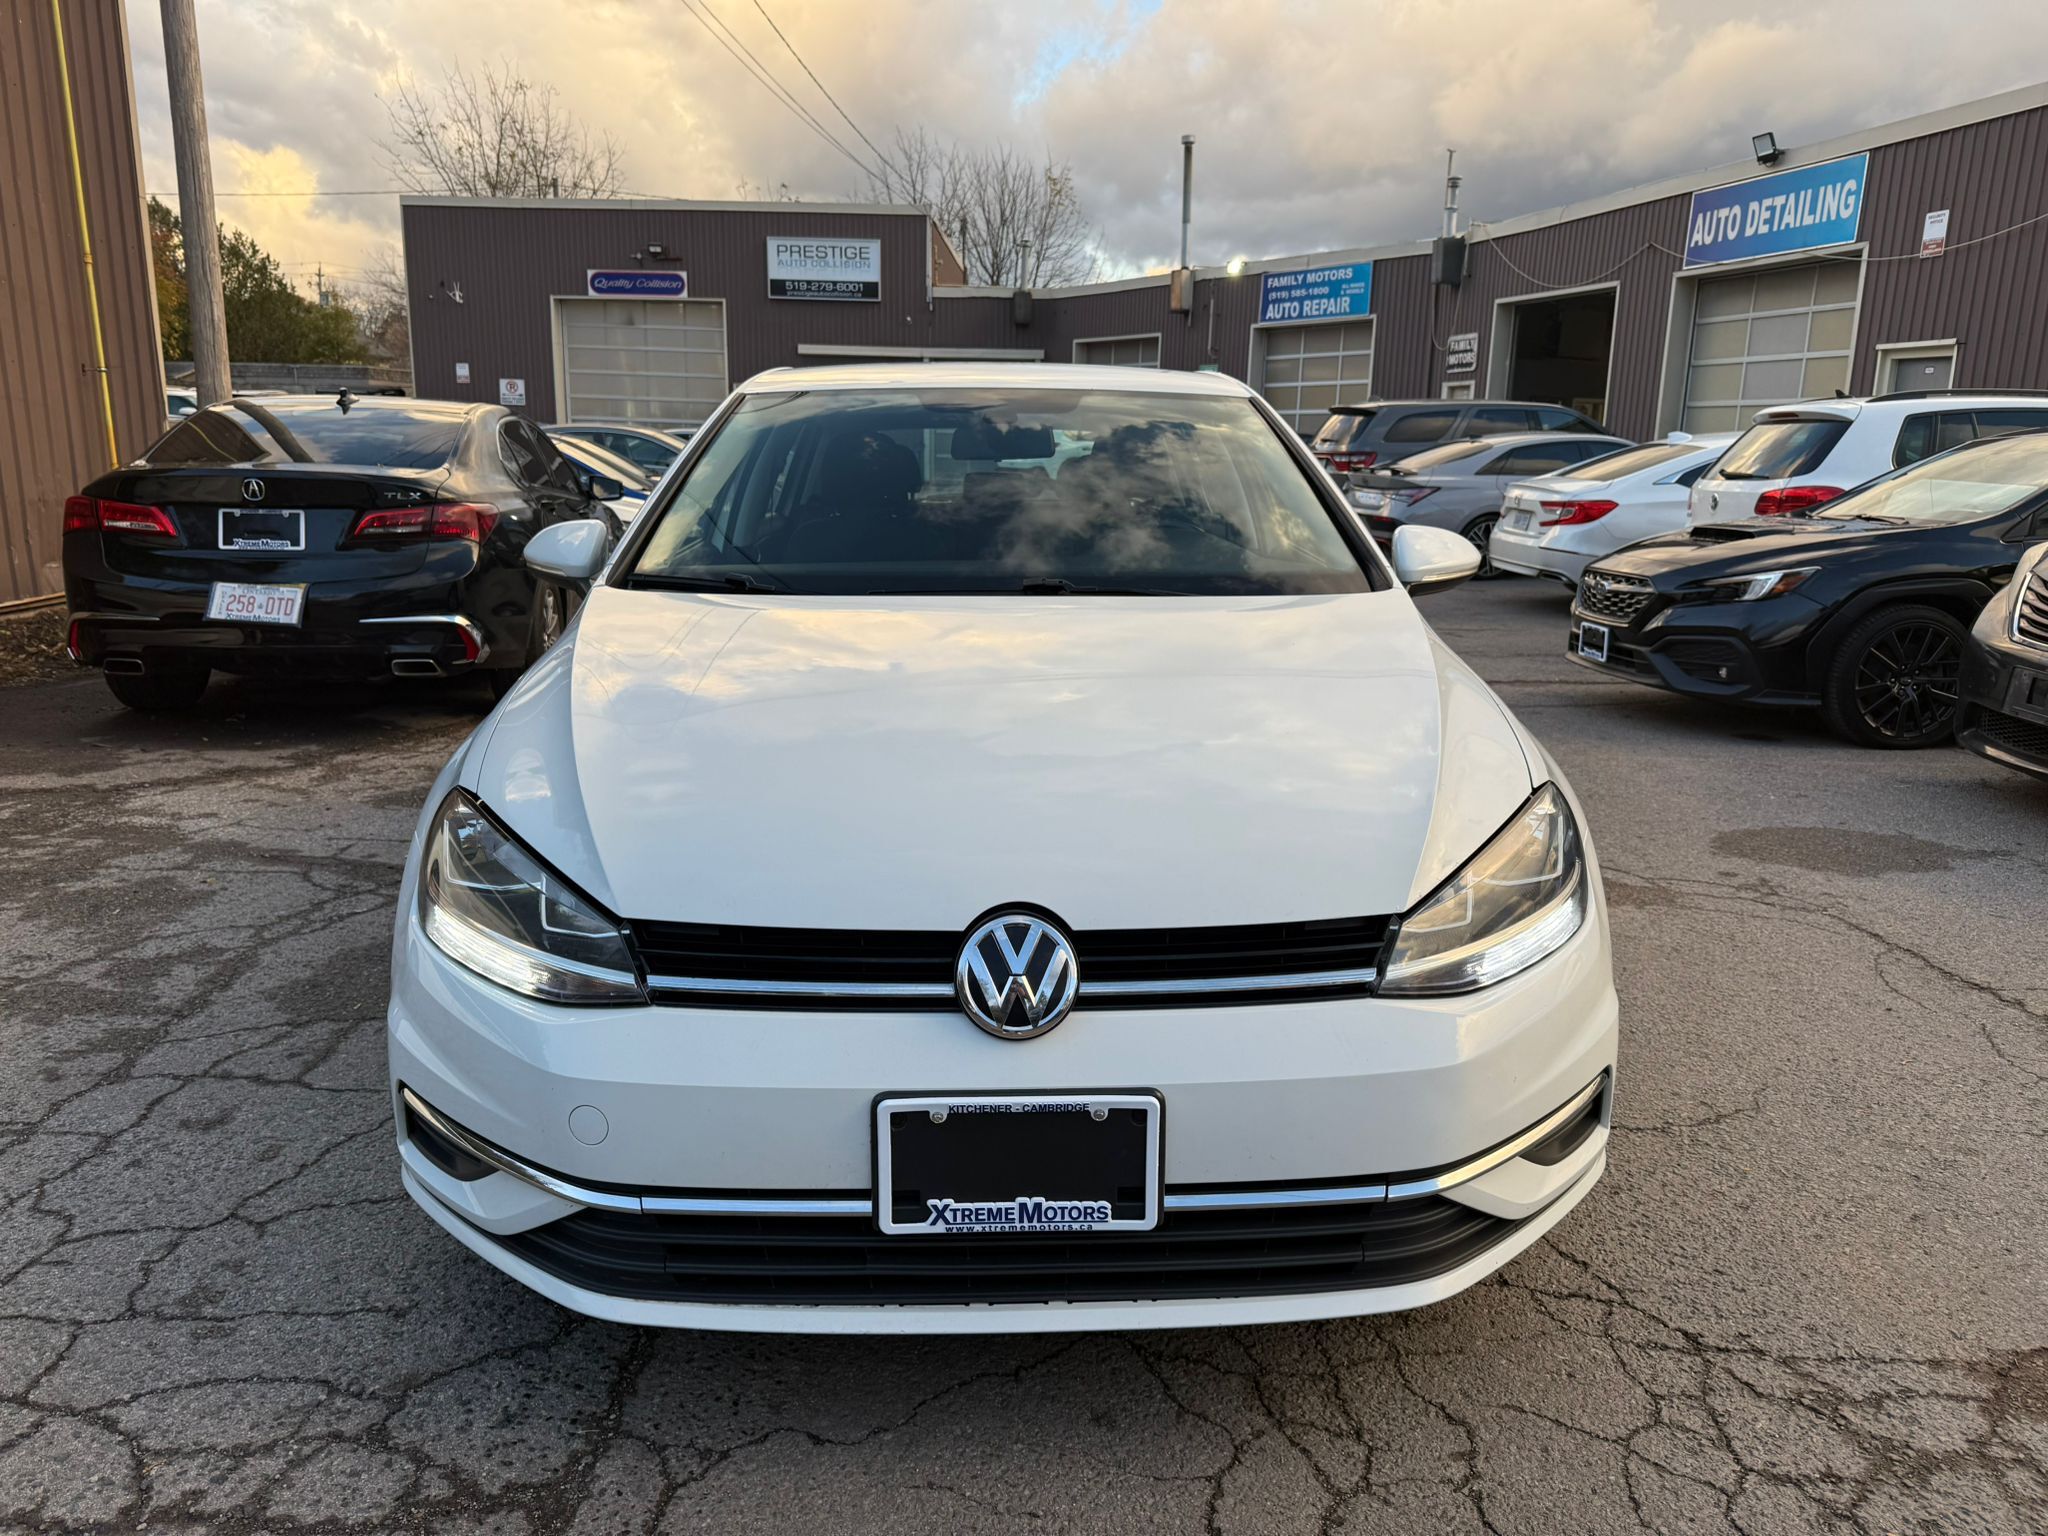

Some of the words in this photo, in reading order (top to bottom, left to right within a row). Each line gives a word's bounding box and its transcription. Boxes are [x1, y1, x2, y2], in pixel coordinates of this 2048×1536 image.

[1690, 204, 1742, 247] AUTO
[1744, 179, 1857, 237] DETAILING
[776, 244, 870, 260] PRESTIGE
[777, 259, 807, 268] AUTO
[811, 260, 871, 269] COLLISION
[594, 277, 634, 289] Quality
[636, 278, 682, 289] Collision
[1267, 274, 1304, 289] FAMILY
[1306, 268, 1353, 284] MOTORS
[785, 281, 864, 292] 519-279-6001
[1268, 291, 1289, 302] (519)
[1265, 302, 1300, 320] AUTO
[1303, 297, 1351, 317] REPAIR
[1449, 340, 1476, 352] FAMILY
[1448, 352, 1475, 365] MOTORS
[384, 492, 421, 500] TLX
[226, 593, 256, 614] 258
[949, 1104, 1012, 1113] KITCHENER
[1022, 1103, 1090, 1113] CAMBRIDGE
[945, 1223, 1093, 1232] www.xtrememotors.ca
